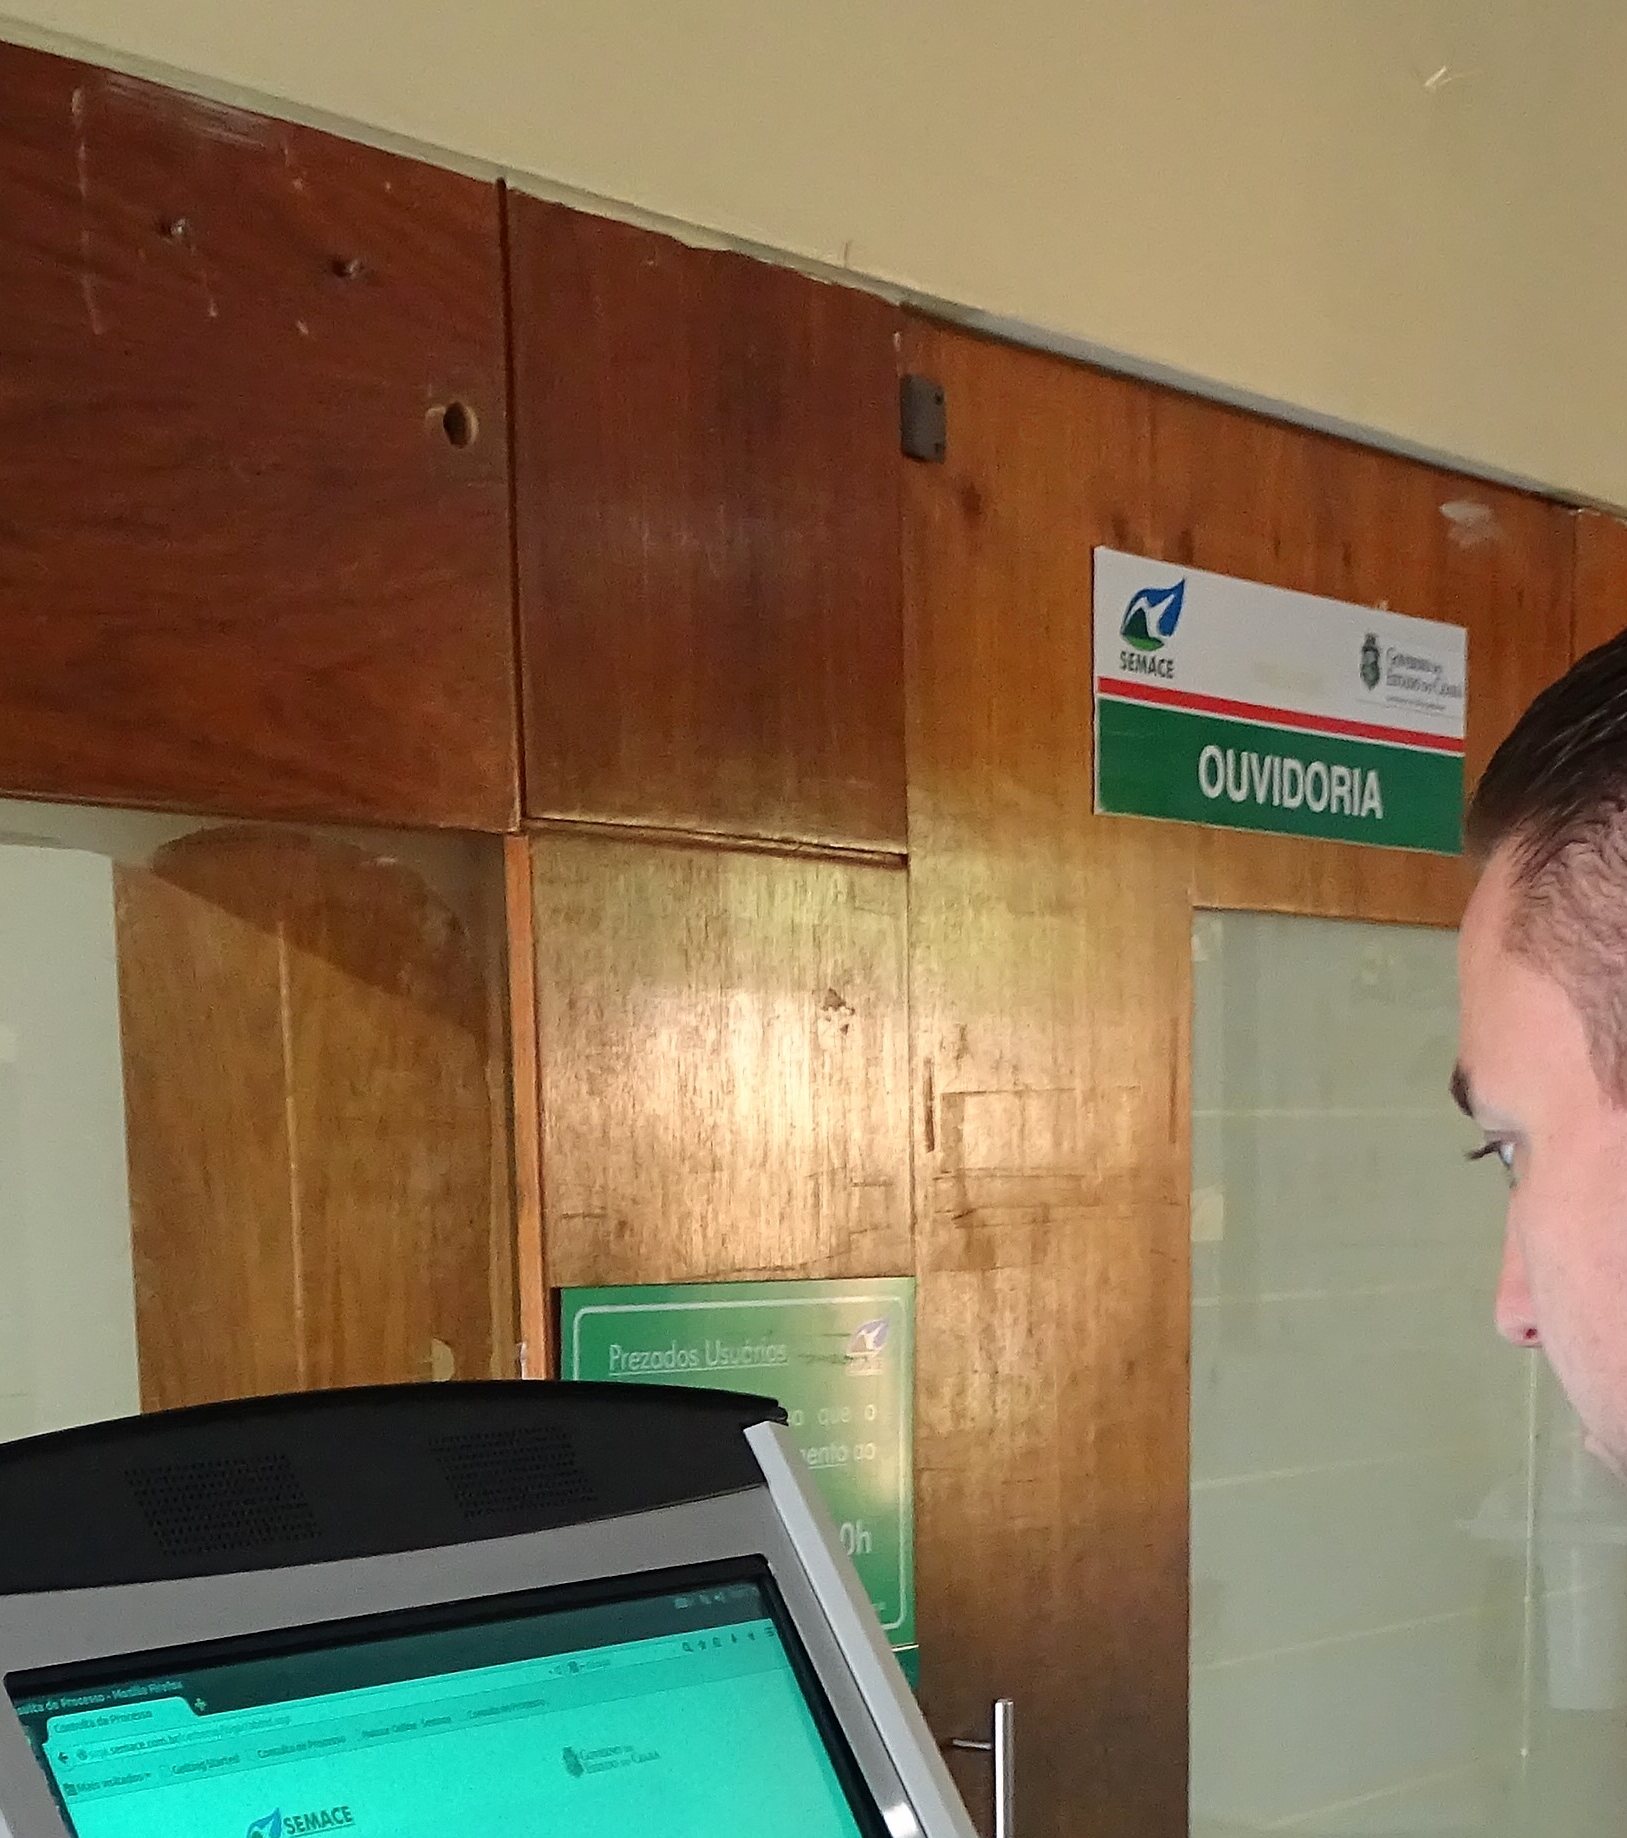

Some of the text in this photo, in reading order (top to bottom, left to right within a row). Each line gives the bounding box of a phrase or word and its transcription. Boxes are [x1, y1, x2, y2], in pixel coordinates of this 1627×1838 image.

[1120, 650, 1174, 679] SEMACE
[1198, 745, 1383, 819] OUVIDORIA
[609, 1340, 699, 1370] Prezados
[818, 1405, 850, 1427] que
[863, 1403, 876, 1423] o
[853, 1442, 876, 1462] ao
[282, 1805, 354, 1836] SEMACE
